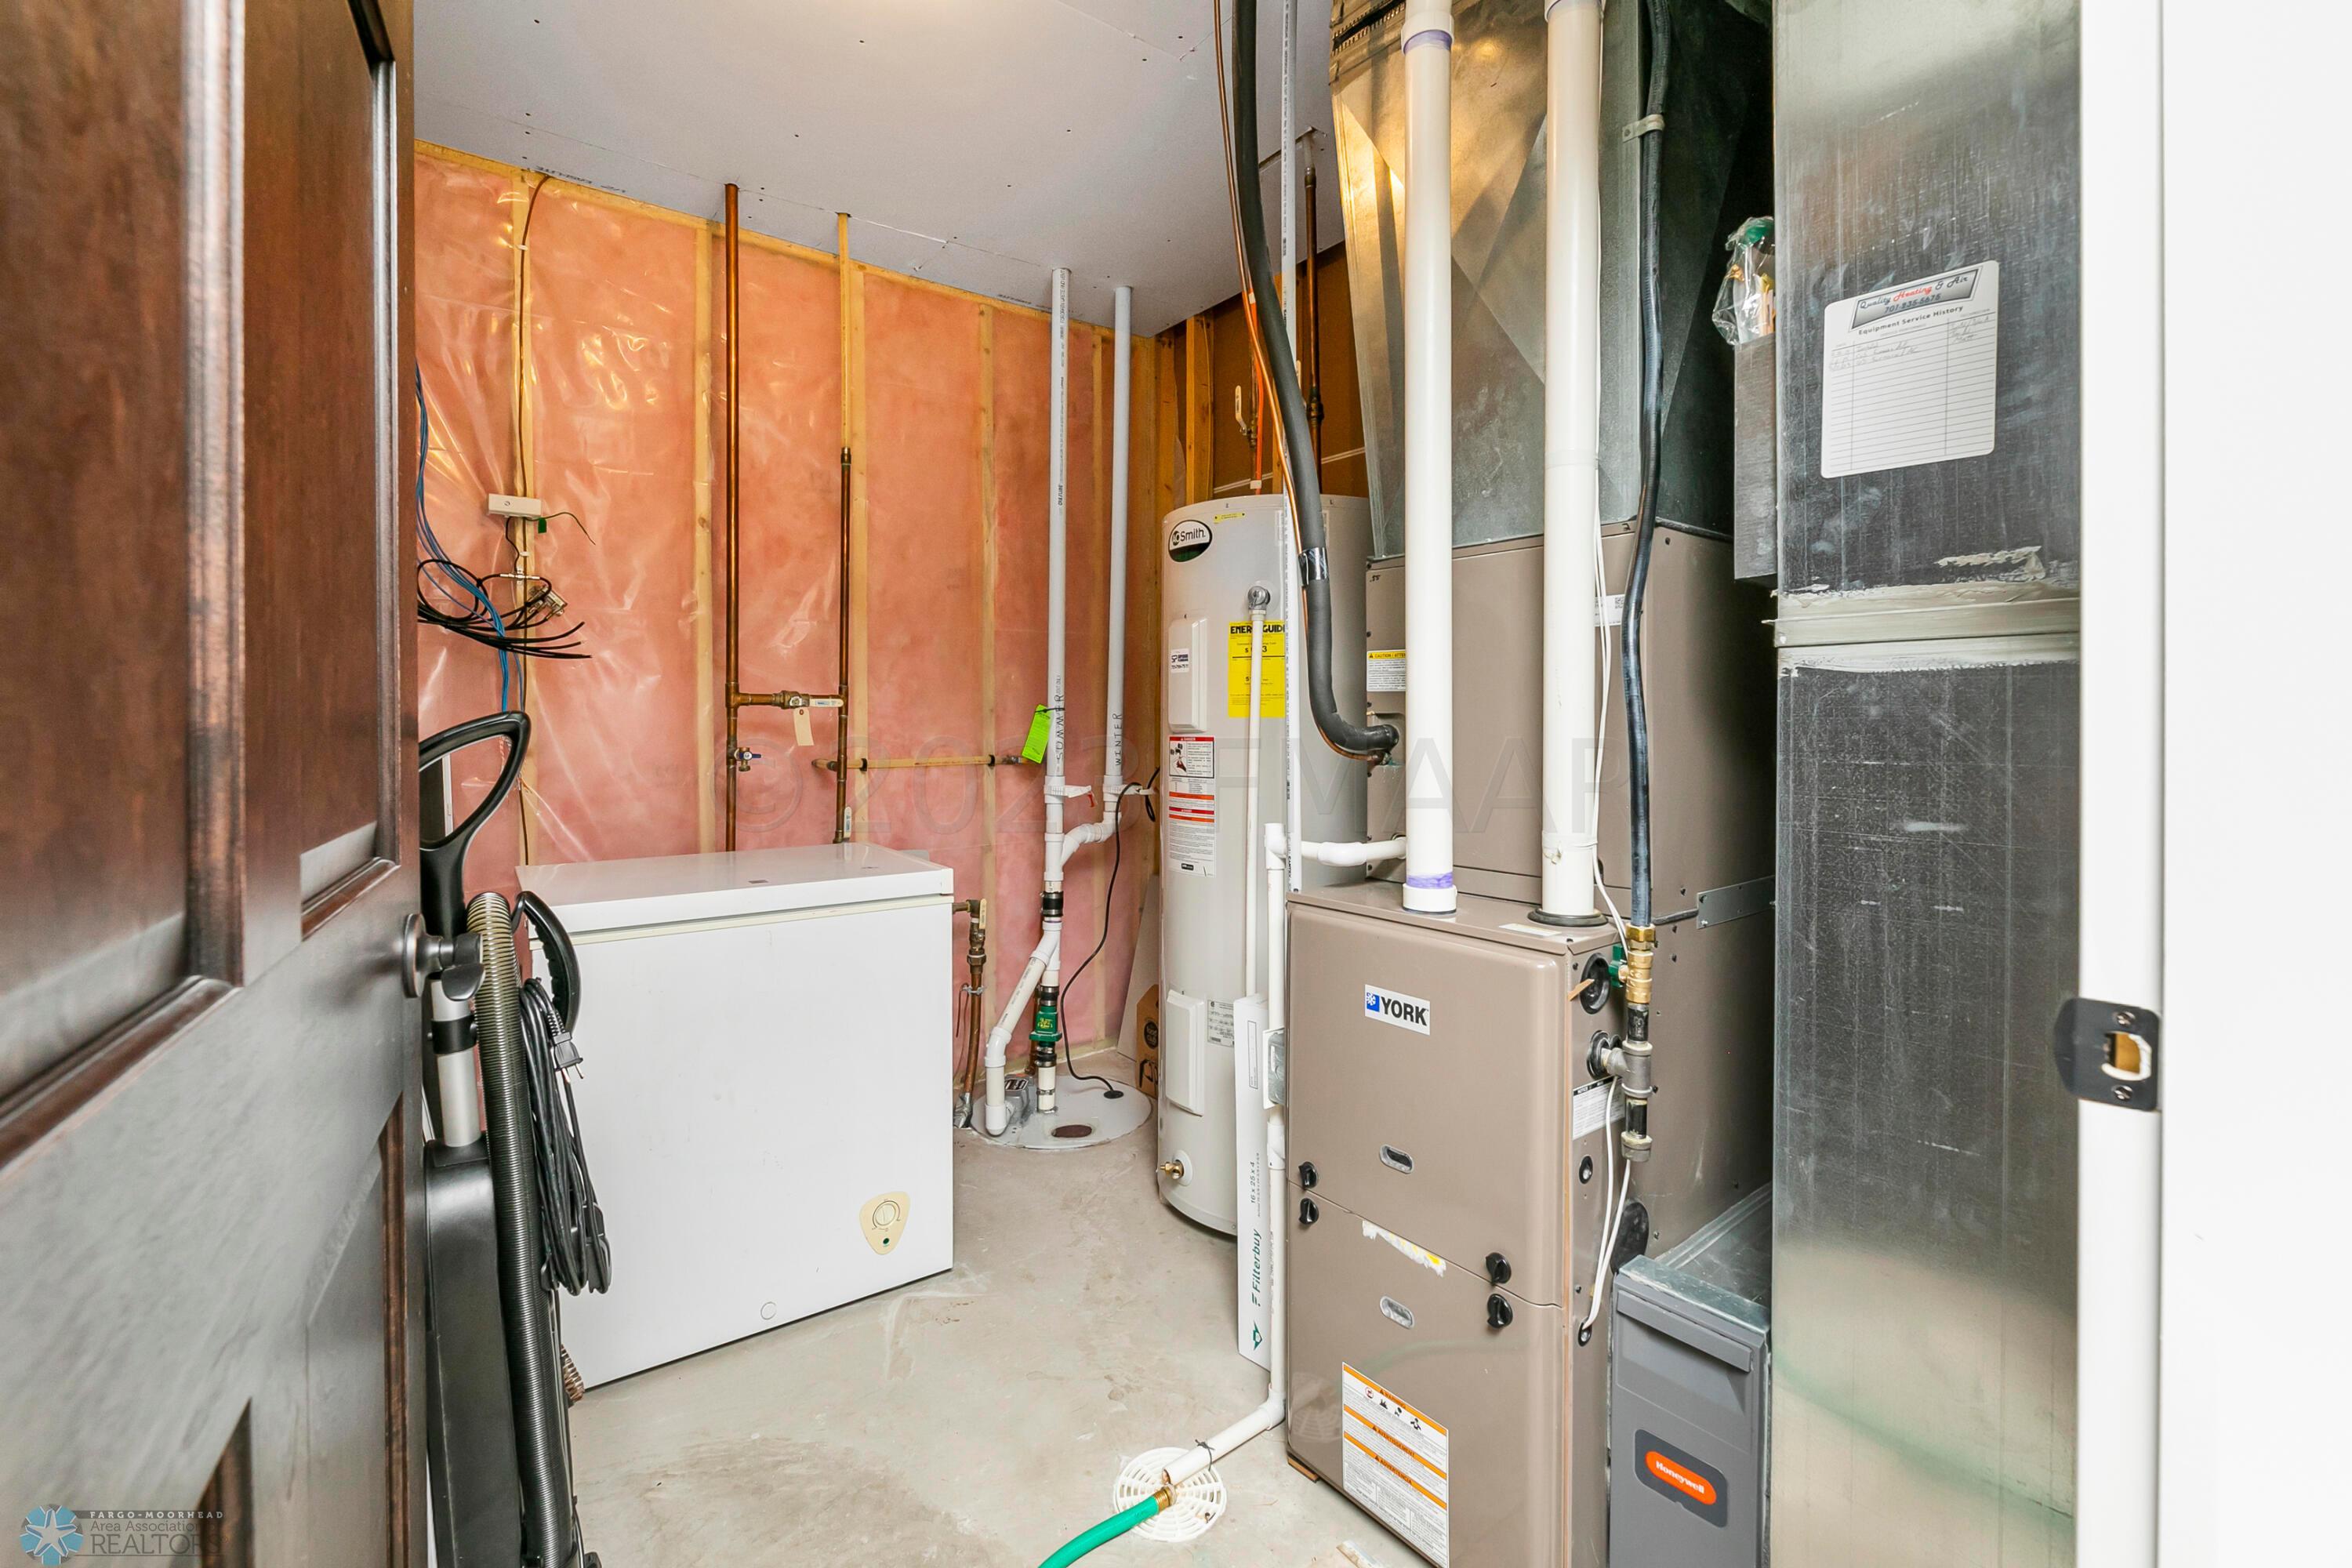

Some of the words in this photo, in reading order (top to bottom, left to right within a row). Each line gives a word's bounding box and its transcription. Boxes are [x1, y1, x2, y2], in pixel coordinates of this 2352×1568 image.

[1860, 295, 1891, 310] Quality
[1893, 285, 1932, 302] Heating
[1935, 280, 1944, 291] &
[1947, 275, 1968, 289] Air
[1858, 321, 1900, 336] Equipment
[1902, 313, 1930, 325] Service
[1933, 306, 1964, 318] History
[1112, 713, 1123, 766] WINTER
[1381, 996, 1428, 1027] YORK
[1250, 1175, 1256, 1187] 25
[1252, 1229, 1262, 1294] Filterbuy
[1655, 1461, 1705, 1494] Honeywell
